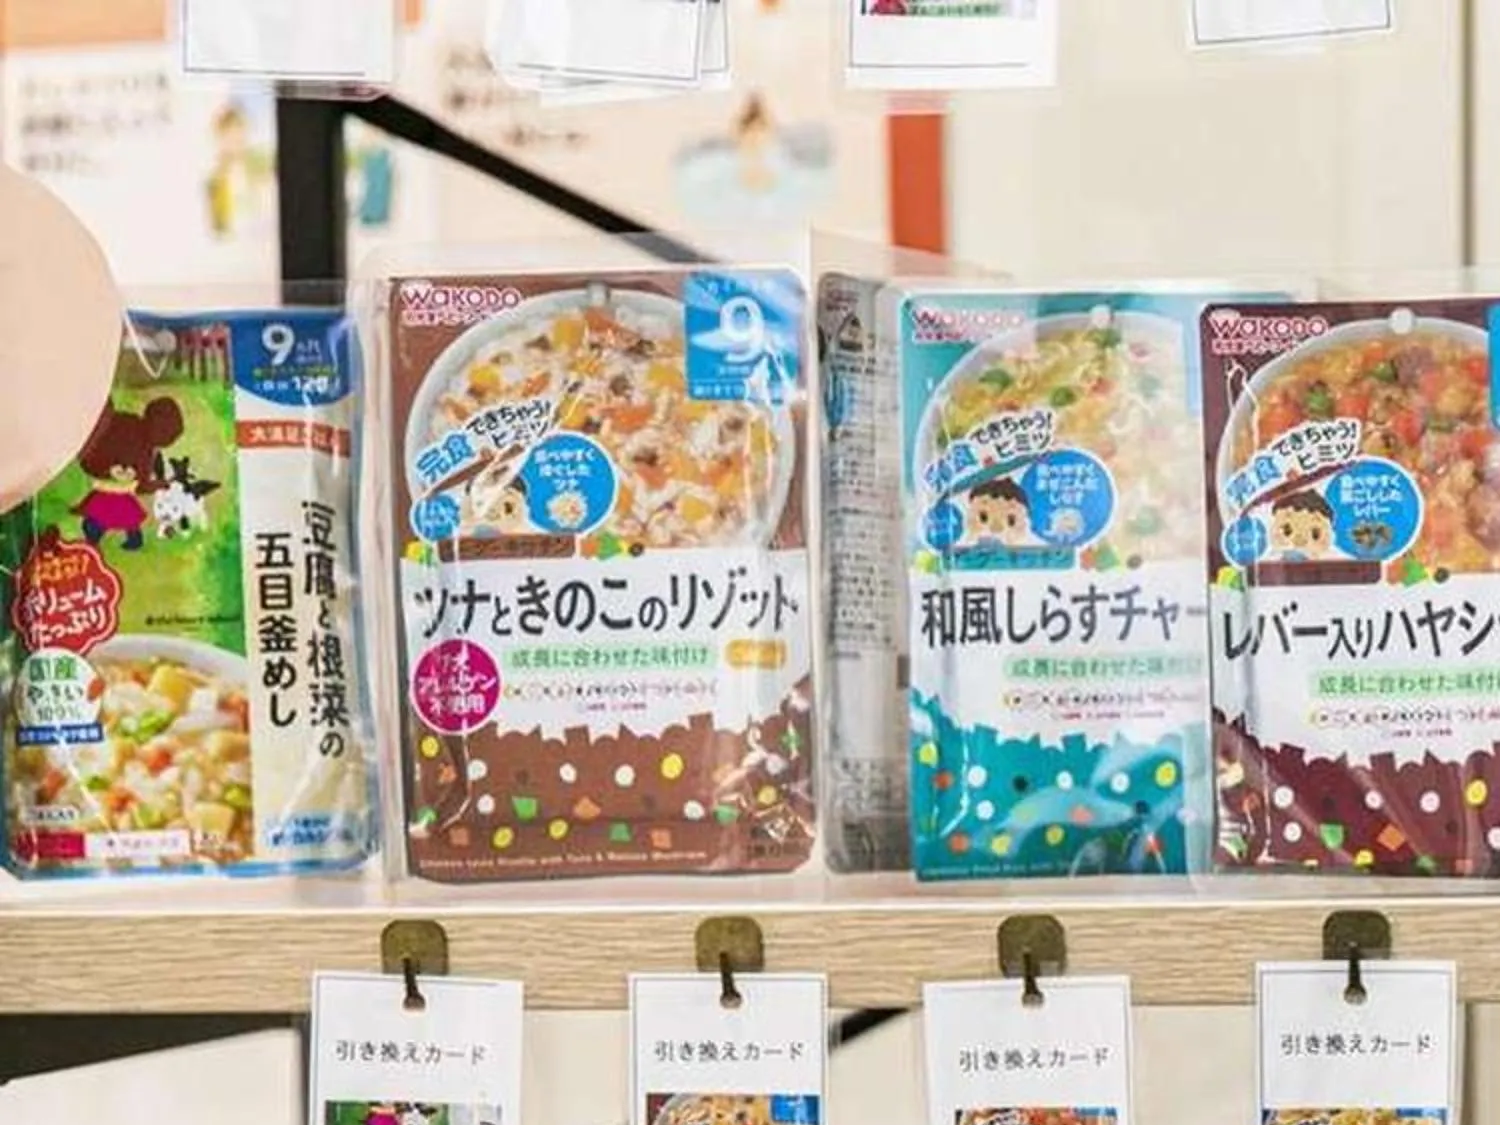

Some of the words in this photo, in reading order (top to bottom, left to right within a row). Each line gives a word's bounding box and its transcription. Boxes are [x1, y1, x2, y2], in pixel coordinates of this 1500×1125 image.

[718, 296, 765, 364] 9
[262, 323, 295, 365] 9
[414, 567, 799, 638] ツナときのこのリゾット
[255, 532, 297, 728] 五目釜めし
[510, 647, 710, 669] 成長に合わせた味付け
[335, 1039, 488, 1065] 引き換えカード
[654, 1041, 805, 1063] 引き換えカード
[1281, 1033, 1433, 1057] 引き換えカード
[959, 1047, 1110, 1073] 引き換えカード
